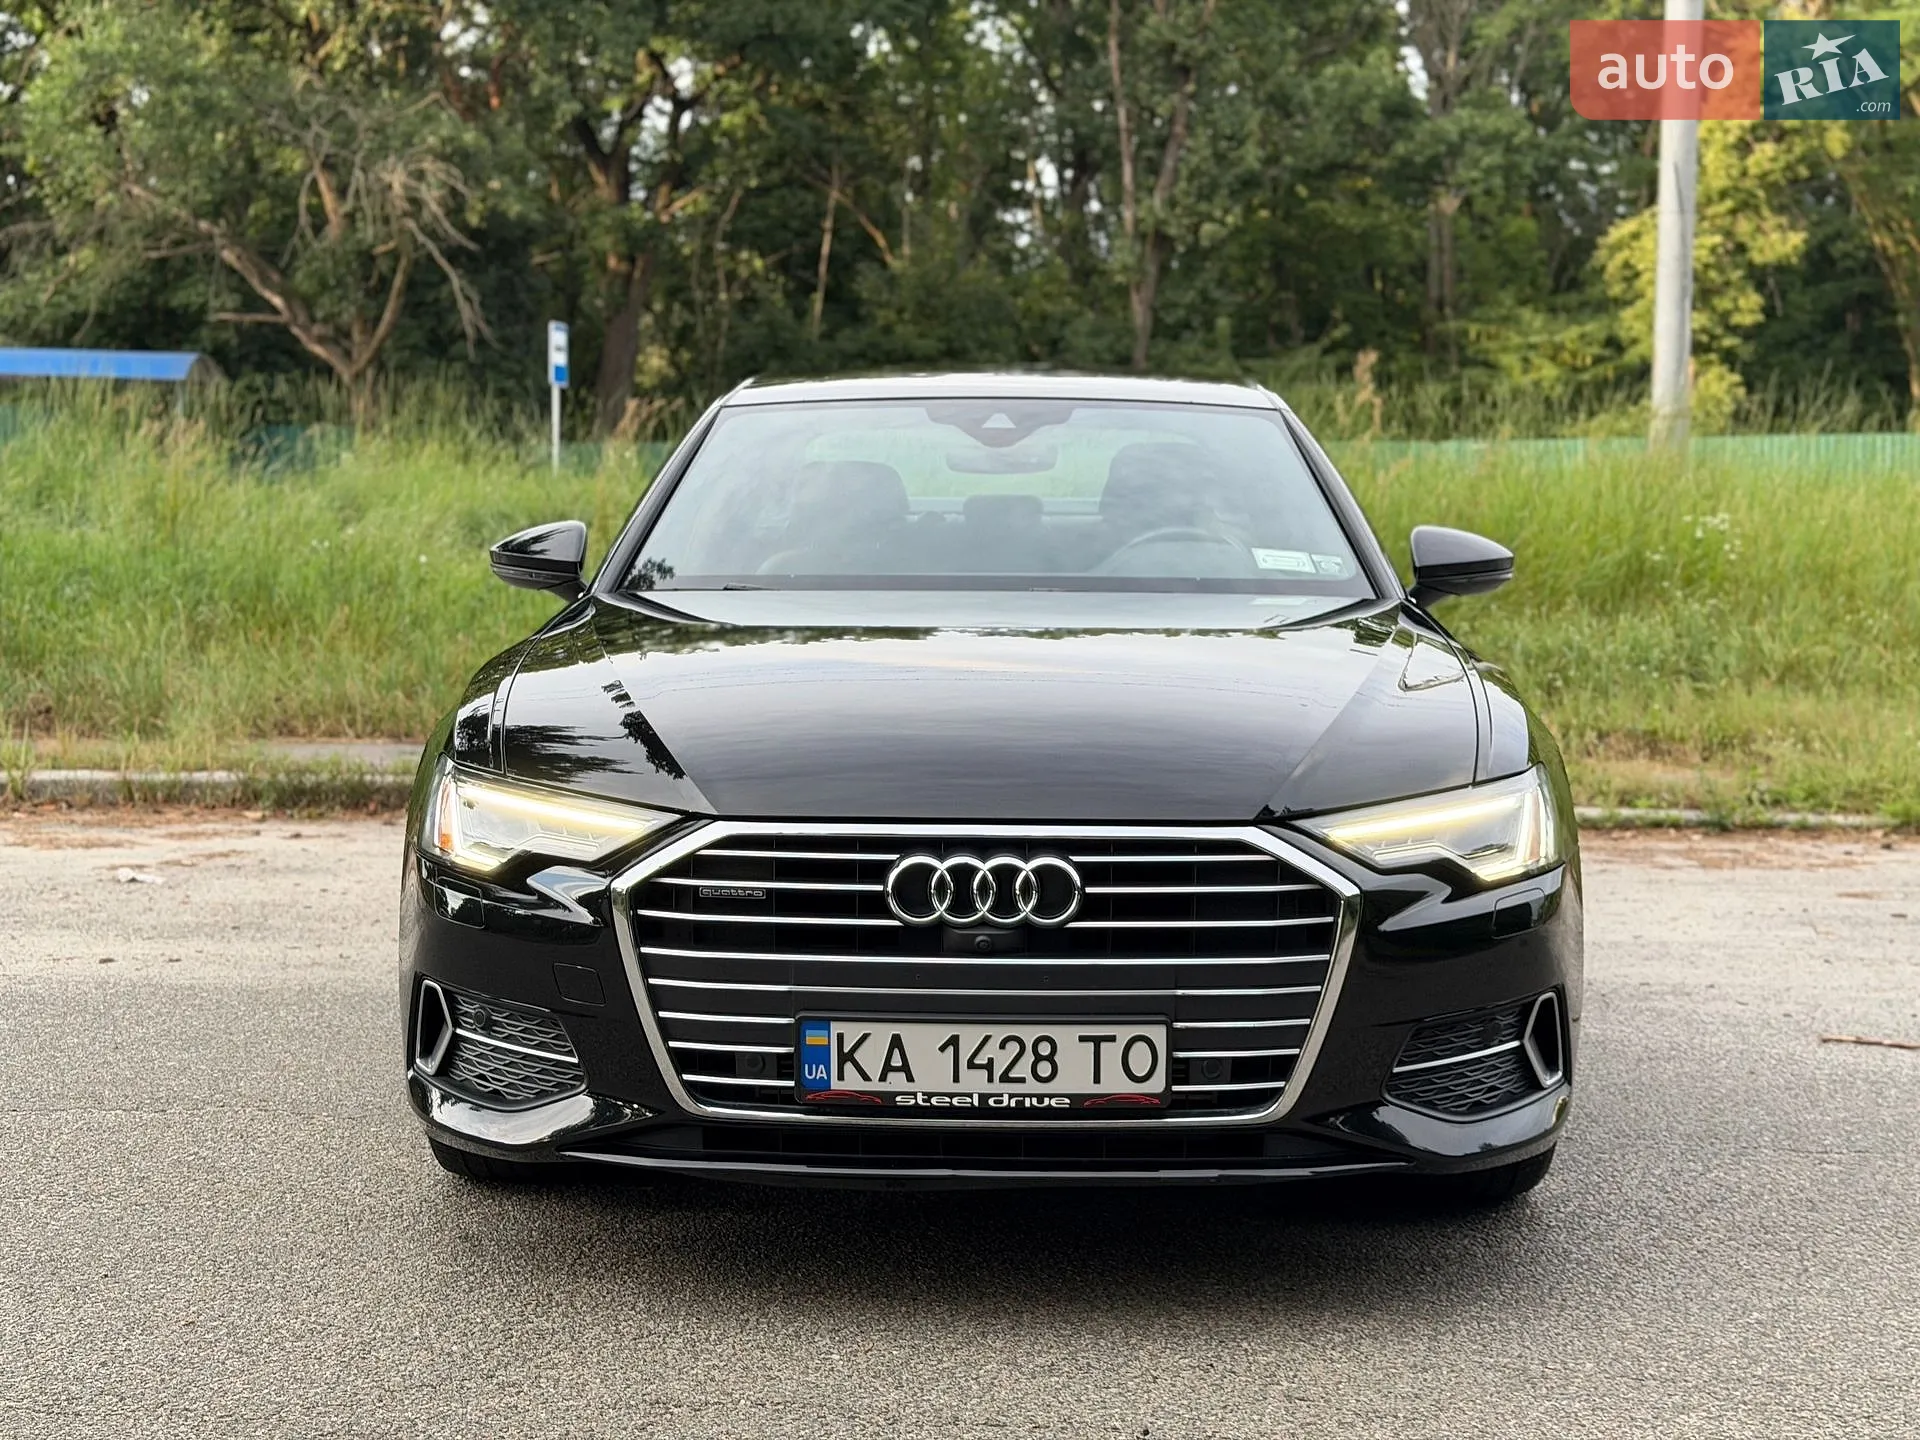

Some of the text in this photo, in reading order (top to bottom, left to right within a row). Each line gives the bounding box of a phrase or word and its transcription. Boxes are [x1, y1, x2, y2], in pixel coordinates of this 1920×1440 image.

[836, 1032, 1159, 1084] KA 1428 TO
[805, 1064, 828, 1080] UA
[895, 1092, 1071, 1108] steel drive
